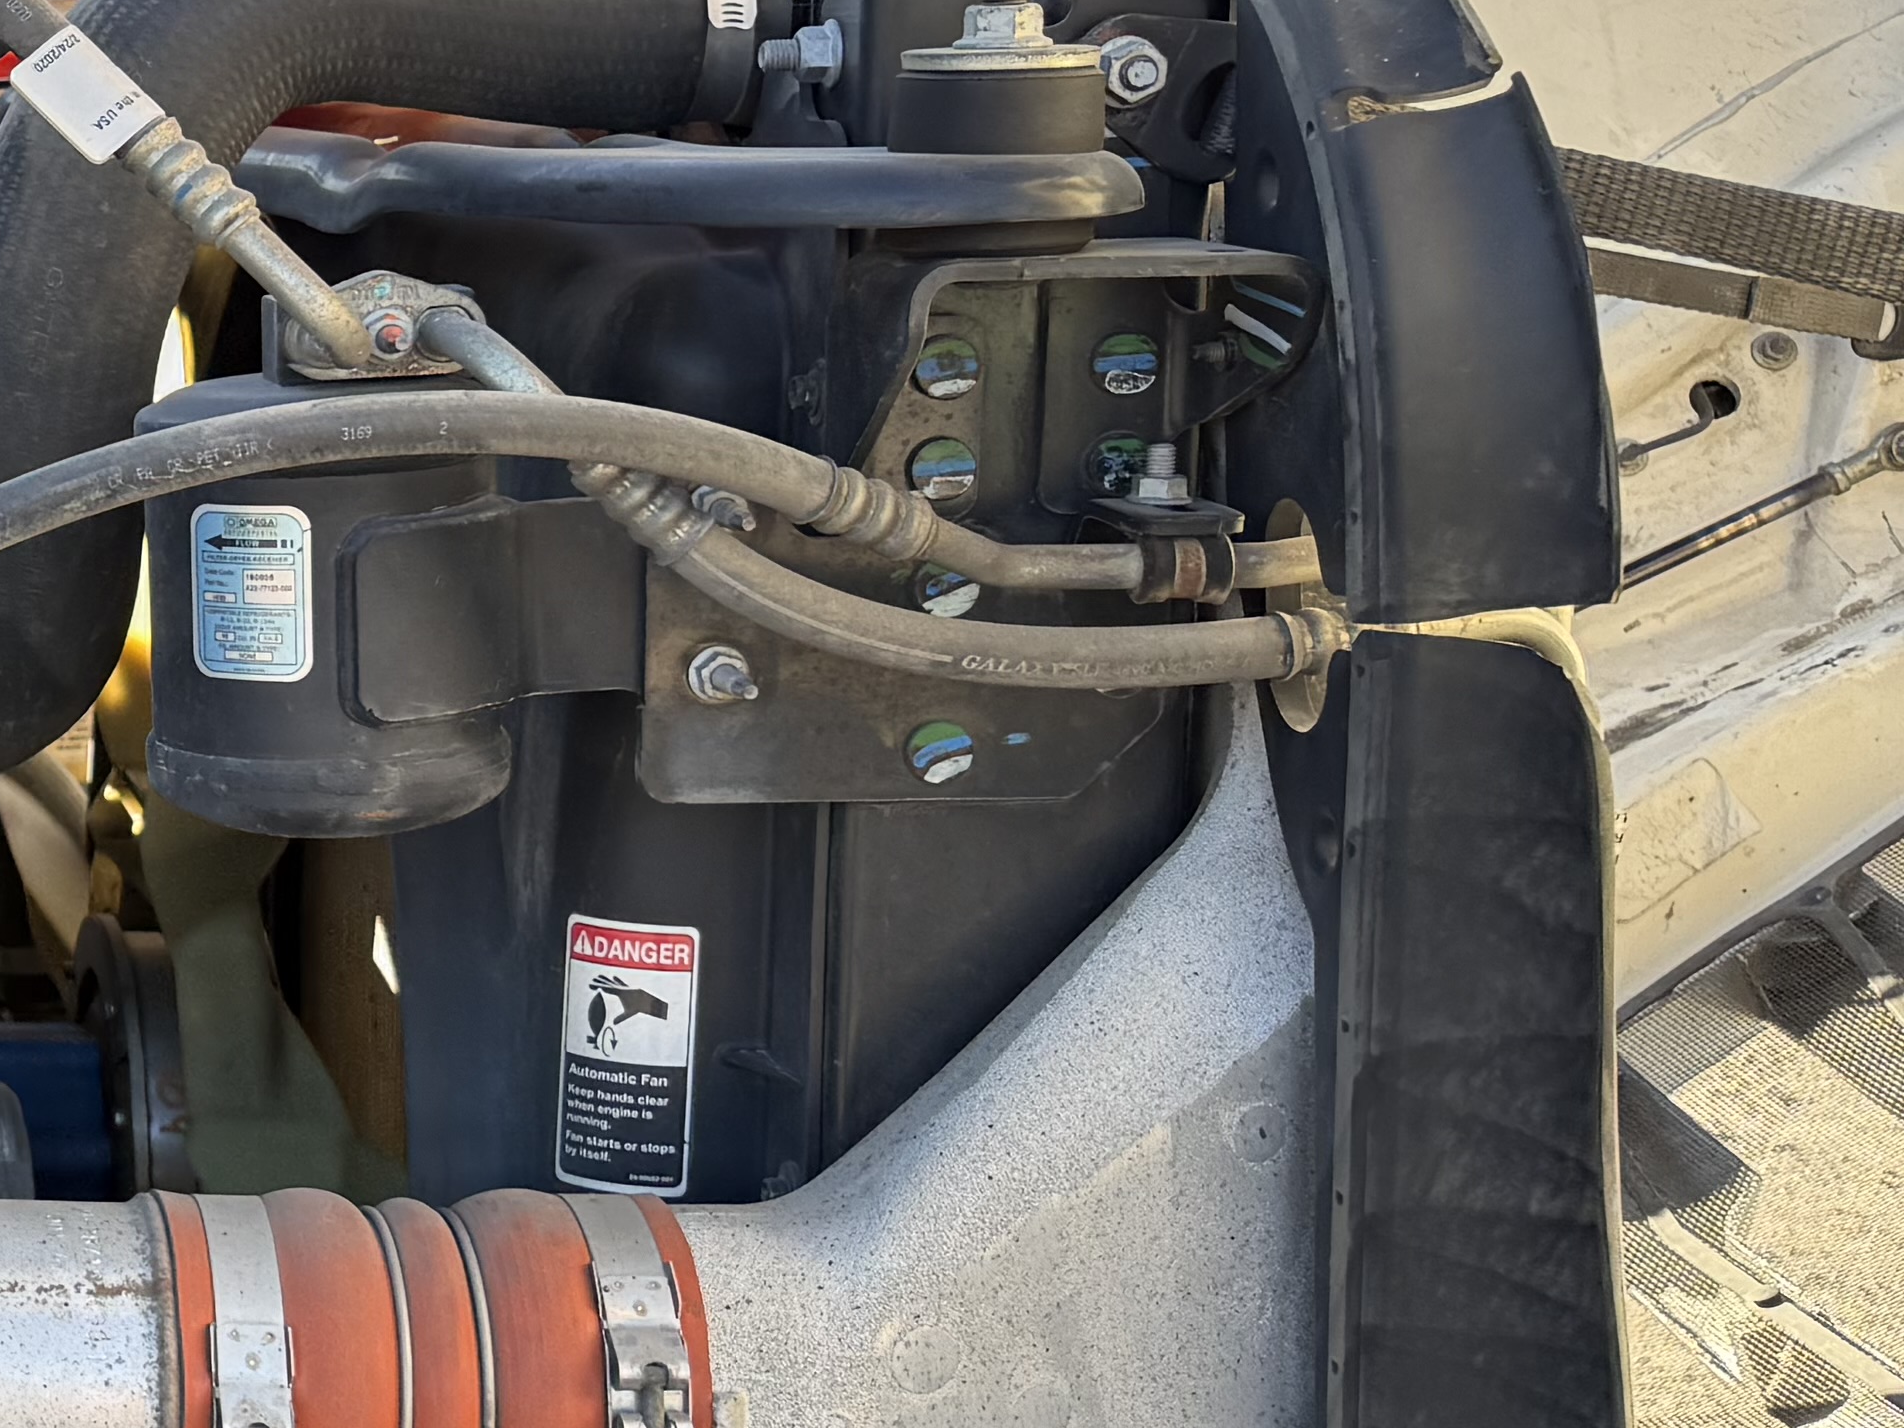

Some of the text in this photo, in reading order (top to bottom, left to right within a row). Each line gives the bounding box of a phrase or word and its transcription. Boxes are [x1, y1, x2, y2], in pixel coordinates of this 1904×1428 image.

[93, 108, 119, 132] USA
[341, 424, 373, 442] 3169
[592, 936, 690, 965] DANGER
[568, 1062, 668, 1088] Automatic Fan
[567, 1083, 670, 1107] Keep hands clear
[567, 1098, 653, 1120] when engine is
[566, 1113, 612, 1131] running.
[565, 1129, 676, 1156] Fan starts or stops
[565, 1144, 612, 1164] by itself.
